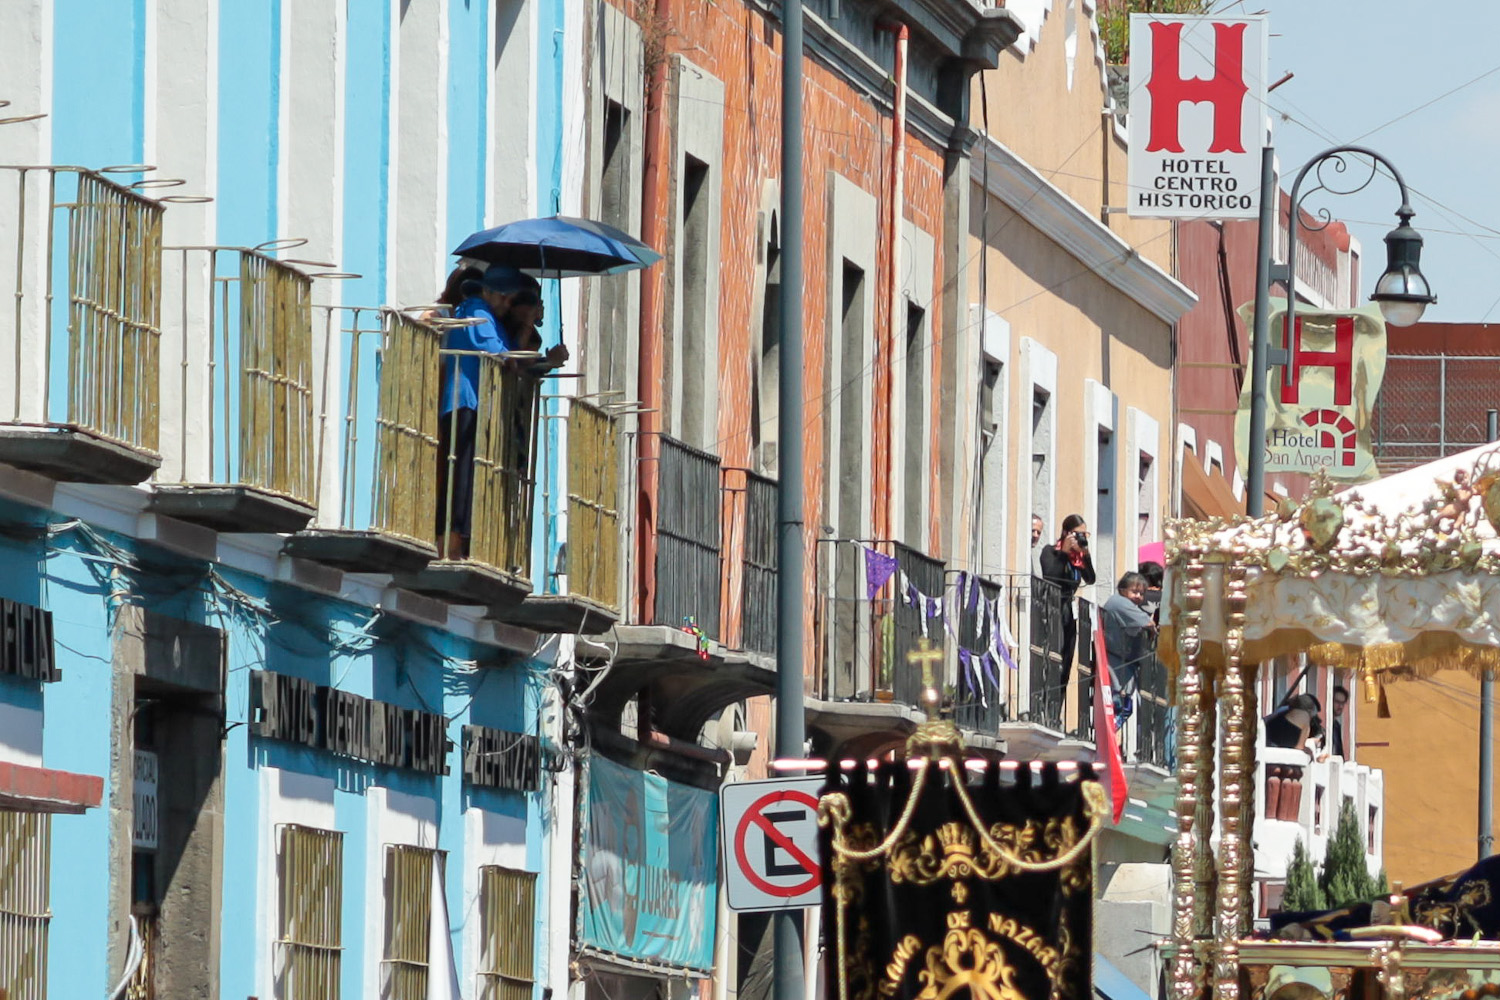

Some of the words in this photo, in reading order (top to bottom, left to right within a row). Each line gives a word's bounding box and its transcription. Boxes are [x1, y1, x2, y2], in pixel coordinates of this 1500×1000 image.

[1145, 21, 1249, 153] H
[1161, 159, 1230, 174] HOTEL
[1154, 176, 1238, 192] CENTRO
[1139, 193, 1252, 210] HISTORICO
[1280, 315, 1354, 406] H
[1272, 429, 1319, 448] Hotel
[1294, 449, 1337, 471] Angel
[0, 598, 62, 683] FICIAL
[947, 910, 970, 929] DE
